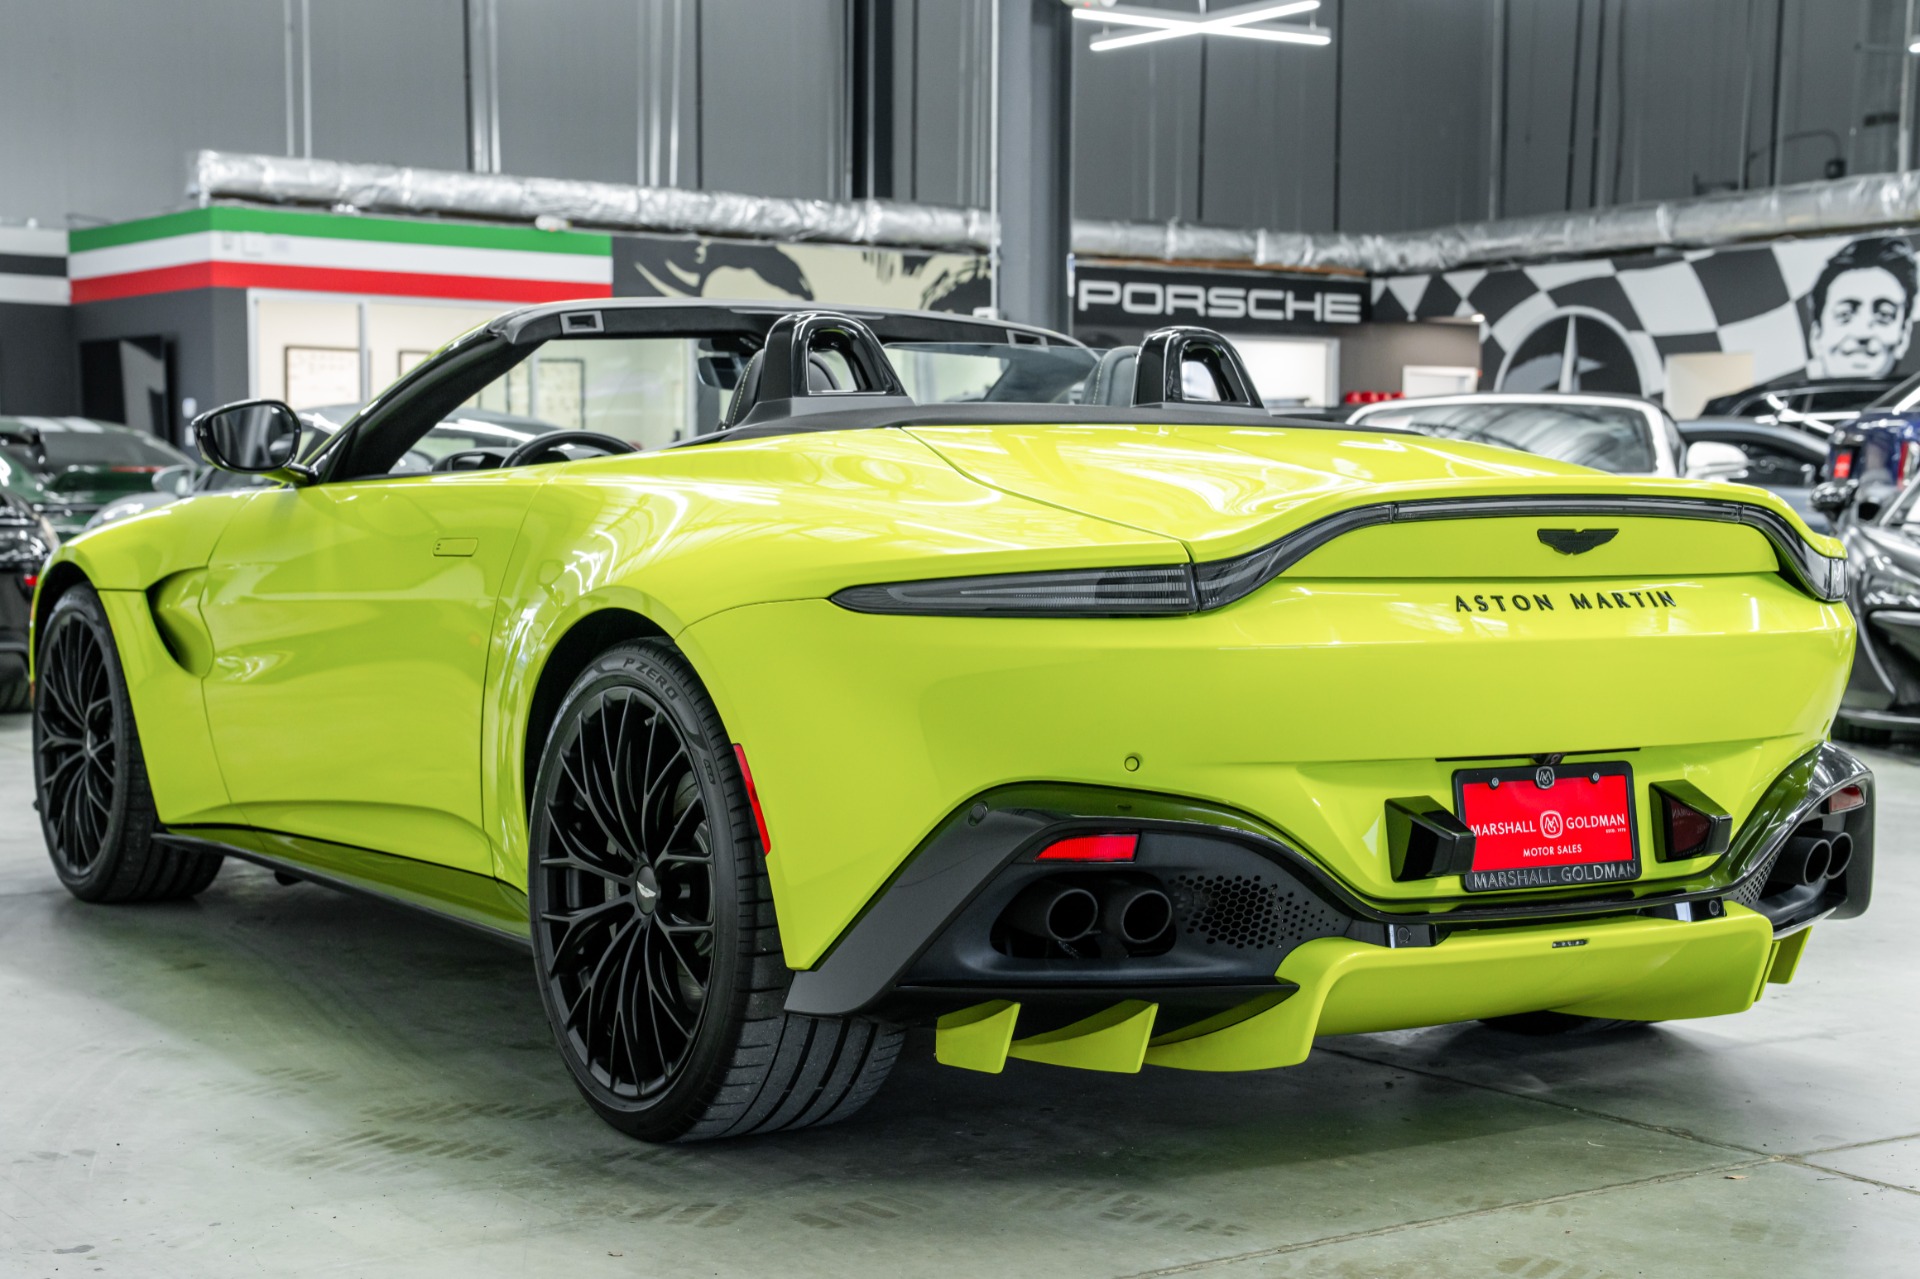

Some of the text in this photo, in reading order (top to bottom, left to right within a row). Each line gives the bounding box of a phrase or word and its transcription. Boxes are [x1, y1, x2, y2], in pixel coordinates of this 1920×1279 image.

[1078, 279, 1362, 323] PORSCHE
[1455, 590, 1677, 612] ASTON MARTIN
[623, 657, 679, 700] P ZERO
[1470, 820, 1537, 837] MARSHALL
[1566, 813, 1626, 829] GOLDMAN
[1523, 844, 1583, 857] MOTOR SALES
[1474, 863, 1637, 889] MARSHALL GOLDMAN
